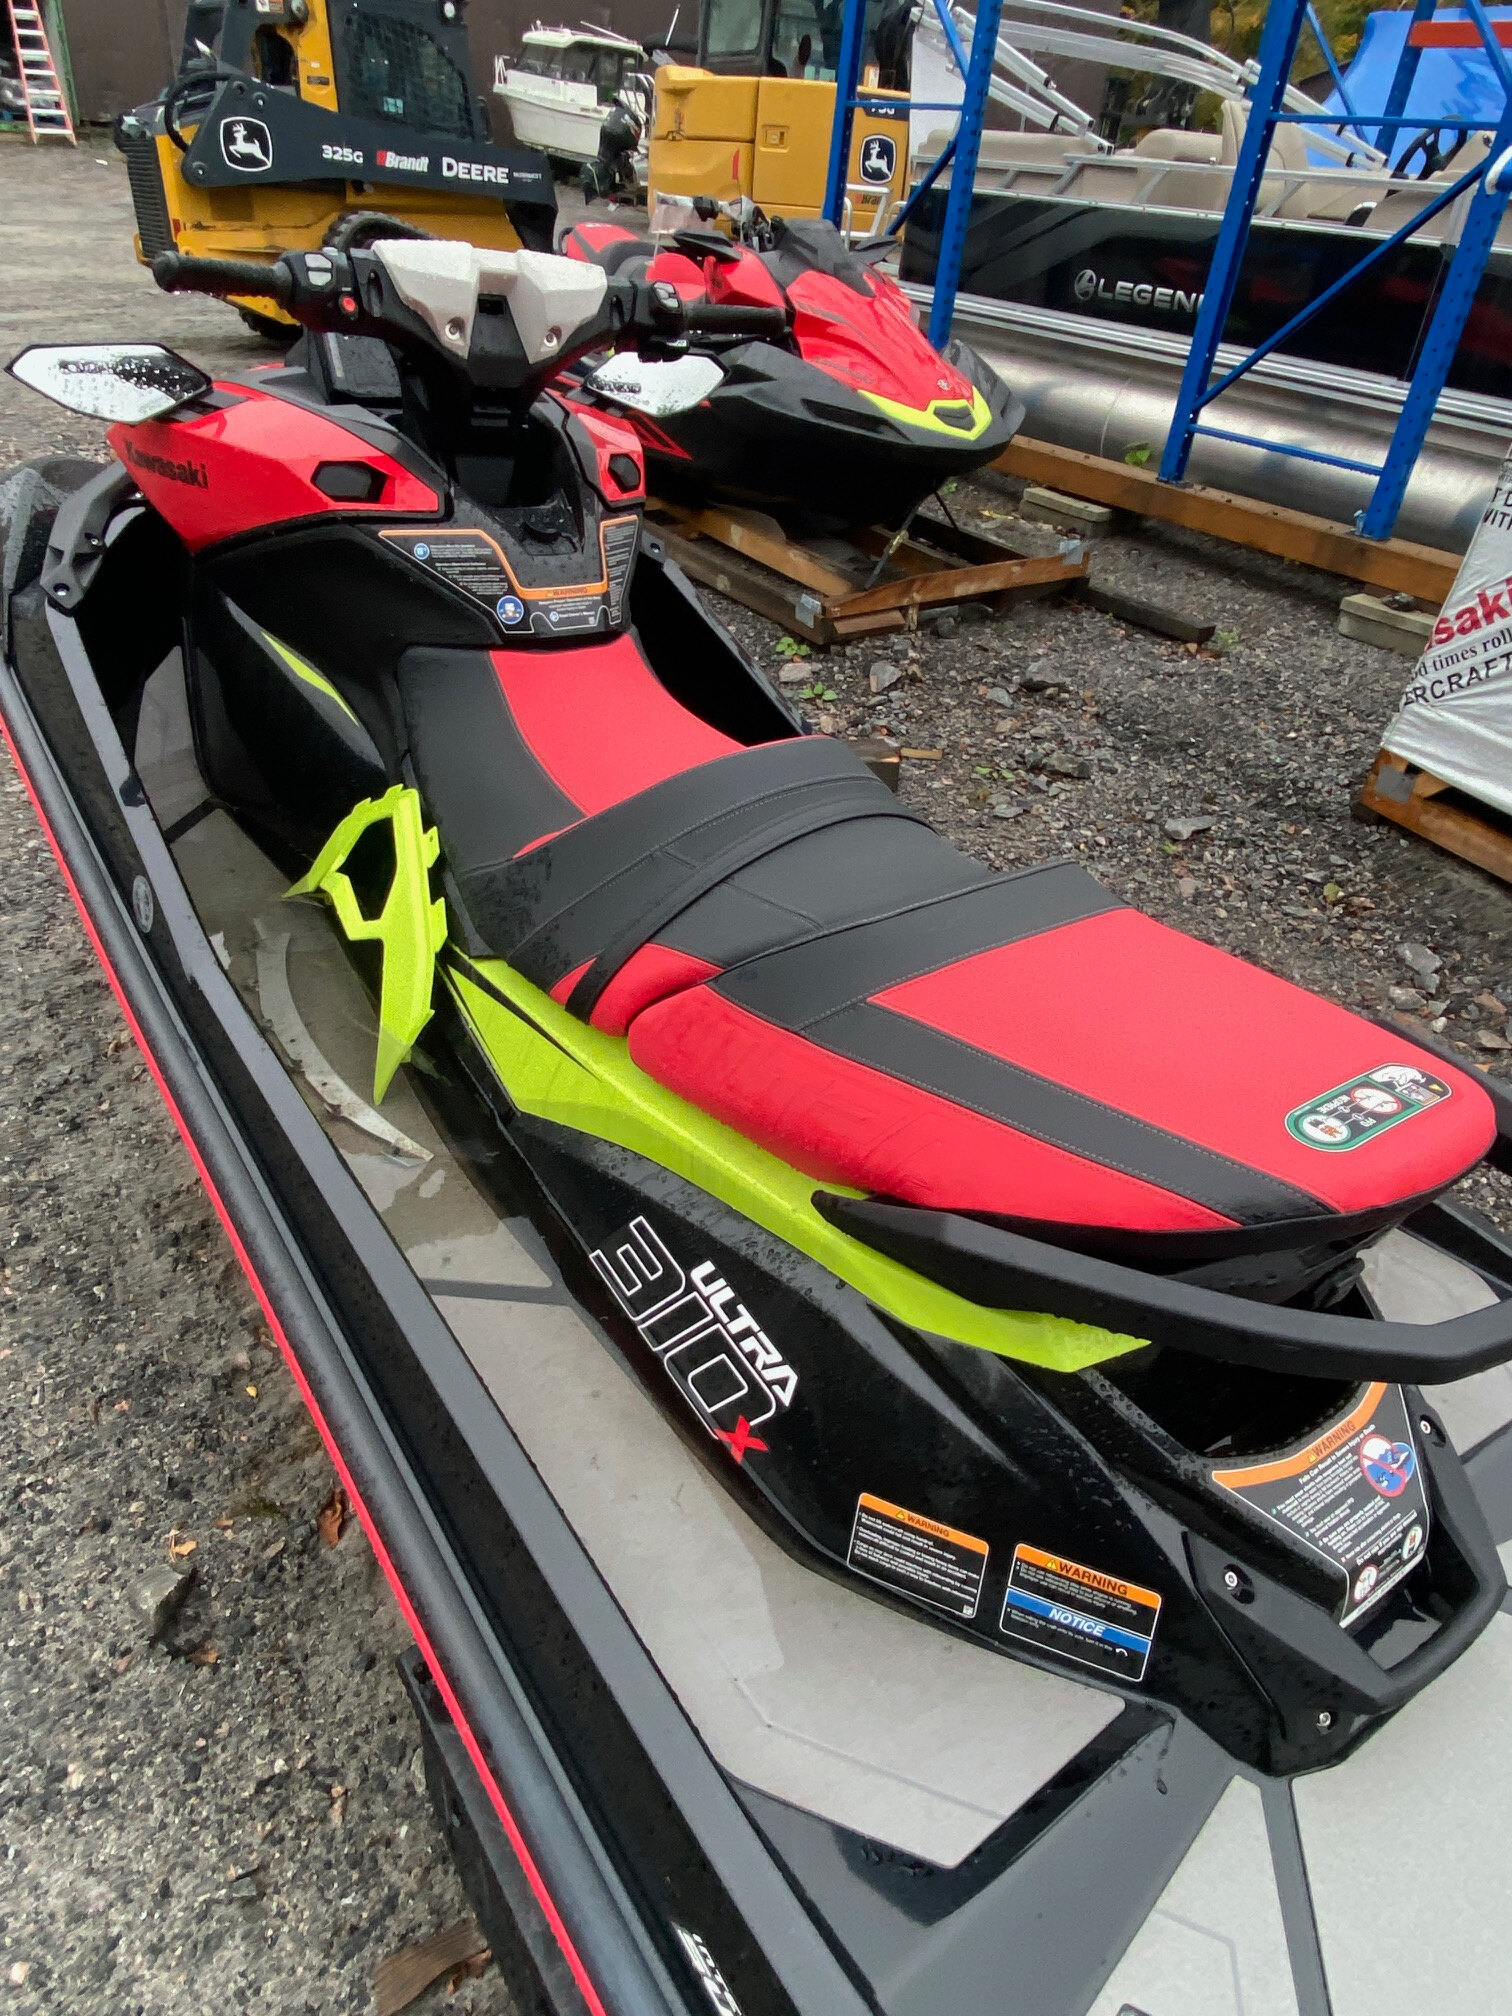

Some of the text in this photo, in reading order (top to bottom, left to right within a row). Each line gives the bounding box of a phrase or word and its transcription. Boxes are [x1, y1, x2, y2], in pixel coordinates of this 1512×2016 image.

[321, 144, 364, 164] 325G
[385, 151, 429, 172] Brandt
[442, 156, 510, 184] DEERE
[124, 440, 209, 490] Kawasaki
[1432, 645, 1478, 672] times
[690, 1260, 799, 1408] ULTRA
[1311, 1420, 1357, 1458] WARNING
[907, 1513, 950, 1538] WARNING
[1059, 1561, 1129, 1597] WARNING
[1048, 1607, 1107, 1637] NOTICE
